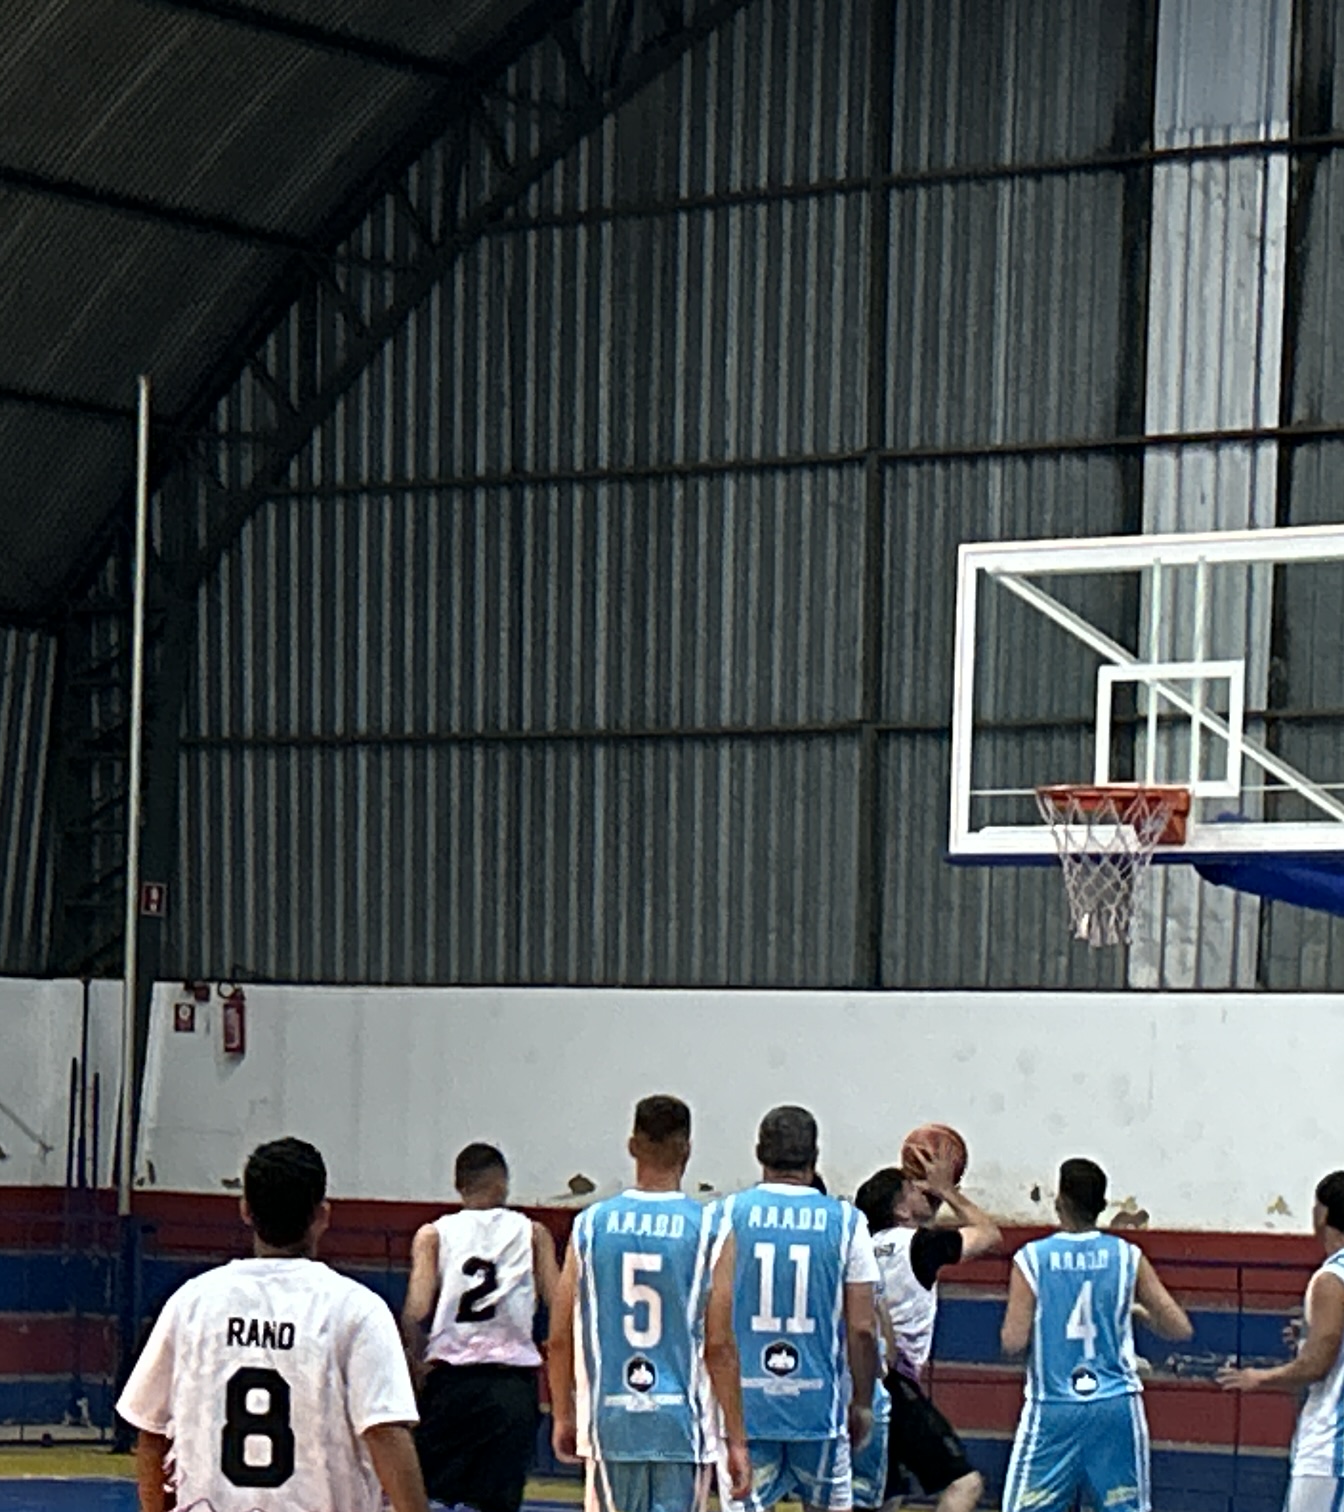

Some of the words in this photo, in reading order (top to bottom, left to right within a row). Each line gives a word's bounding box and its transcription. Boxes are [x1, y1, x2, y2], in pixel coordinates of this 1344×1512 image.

[456, 1256, 497, 1323] 2
[621, 1252, 663, 1348] 5
[751, 1242, 816, 1334] 11
[1066, 1280, 1098, 1360] 4
[221, 1366, 295, 1488] 8
